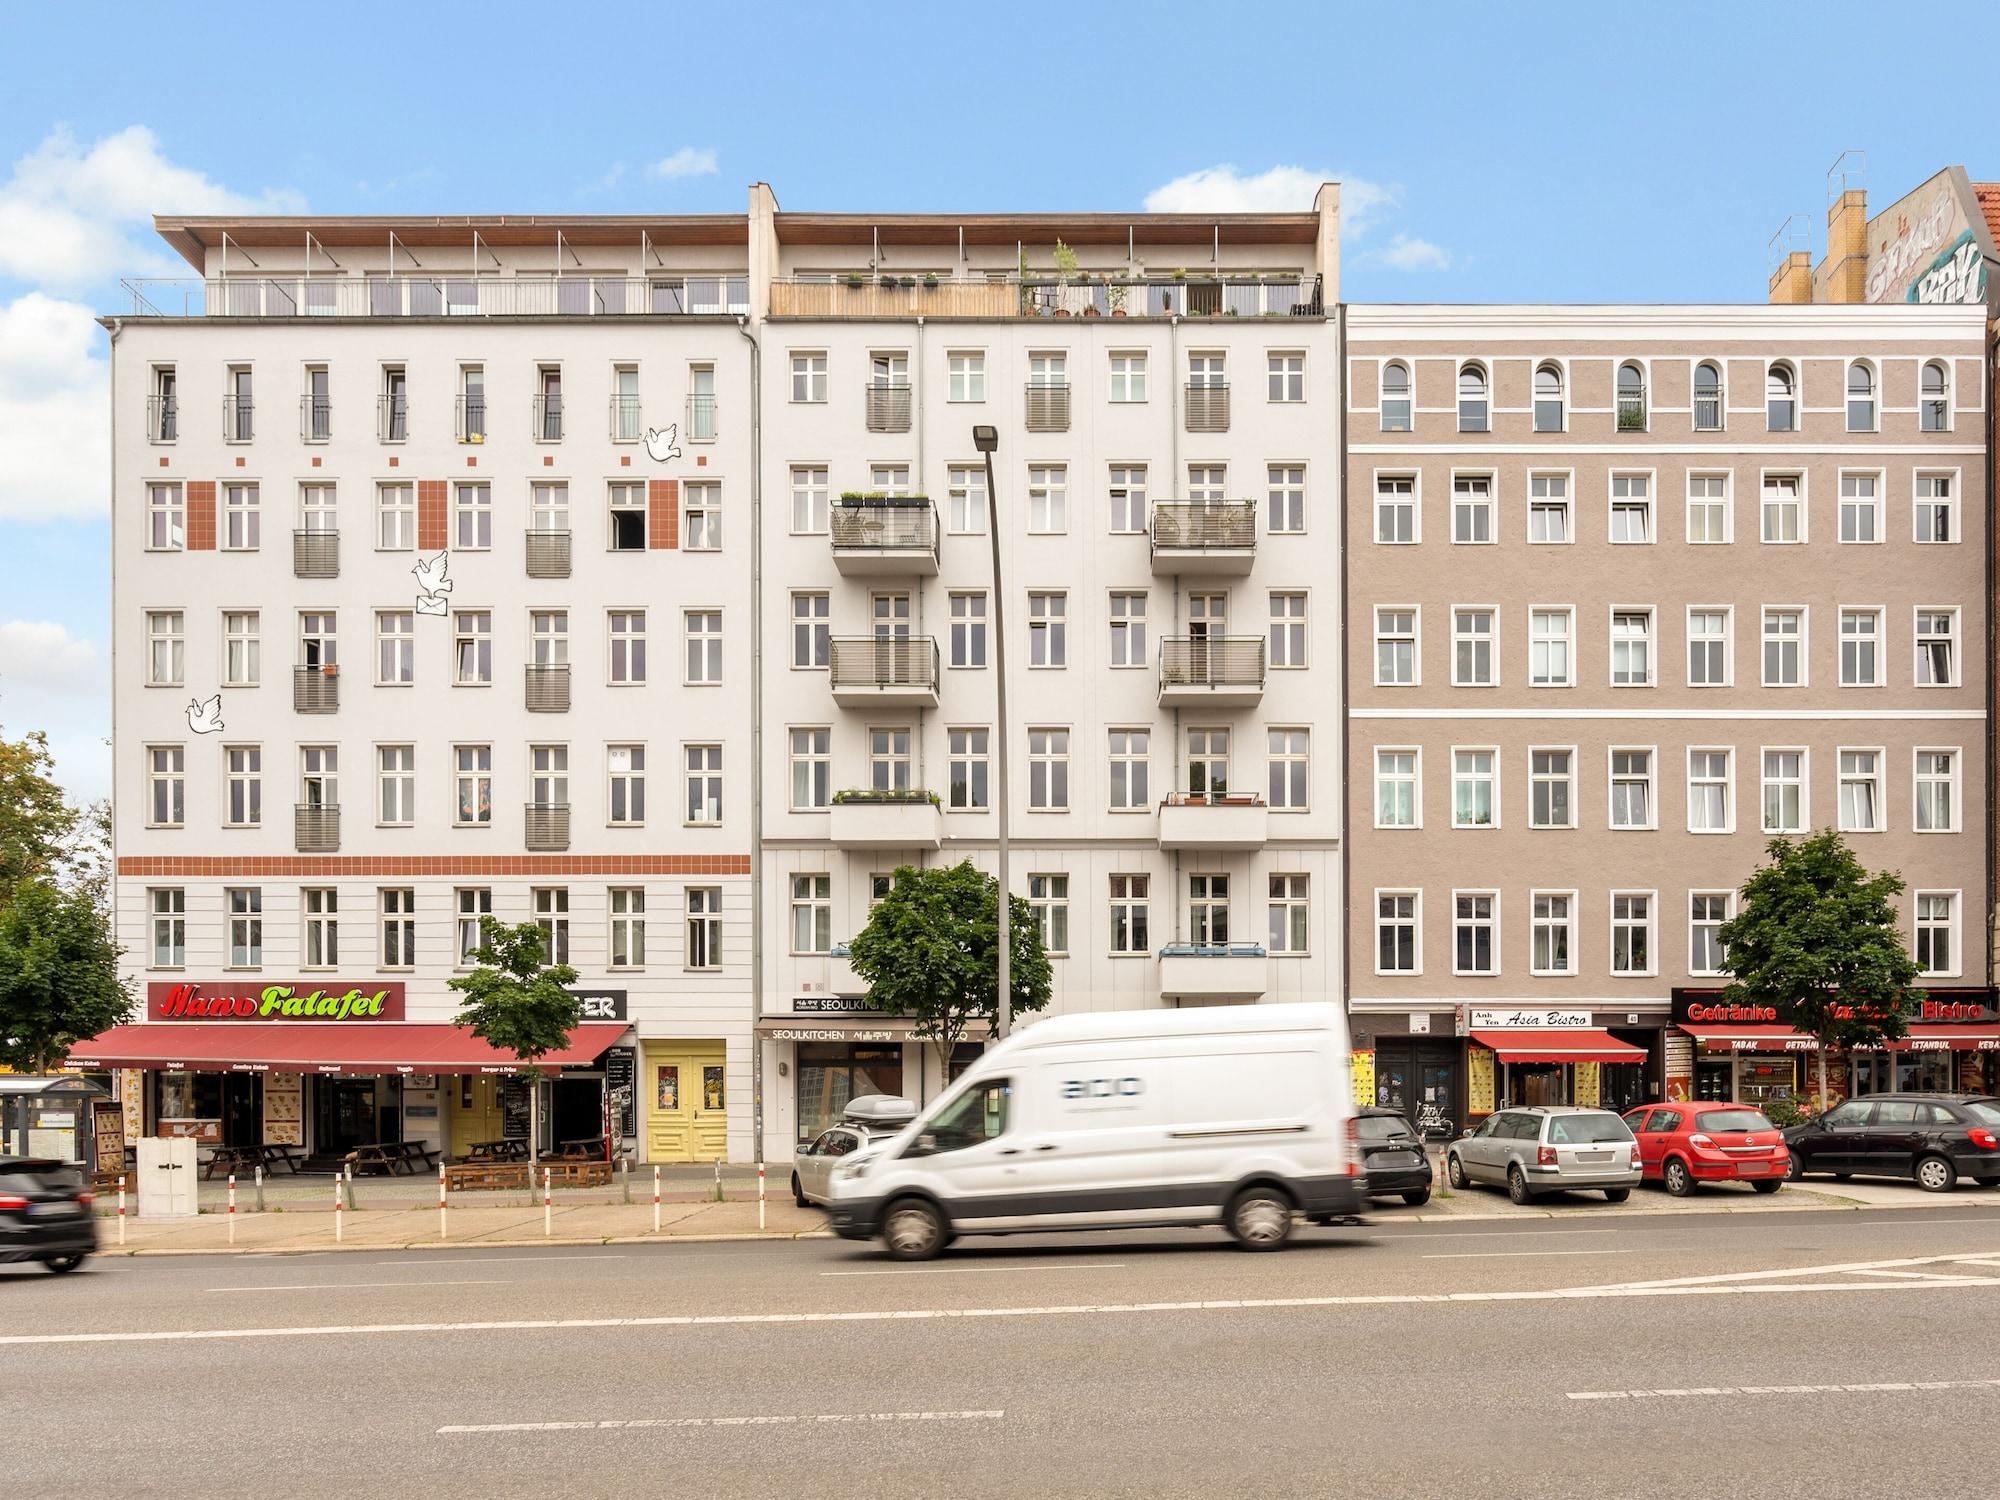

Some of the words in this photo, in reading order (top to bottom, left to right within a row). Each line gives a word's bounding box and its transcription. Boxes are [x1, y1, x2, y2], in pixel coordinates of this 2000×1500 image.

[260, 985, 391, 1020] Falafel
[574, 996, 616, 1018] ER
[821, 1000, 880, 1010] SEOULKIT
[1688, 1003, 1777, 1020] Getränke
[1920, 1000, 1983, 1019] Bistro
[1506, 1011, 1541, 1026] Asia
[1547, 1011, 1587, 1025] Bistro
[772, 1029, 845, 1040] SEOULKITCHEN
[1731, 1040, 1758, 1049] TABAK
[1785, 1039, 1828, 1049] GETRÄN
[1911, 1040, 1950, 1049] ISTANBUL
